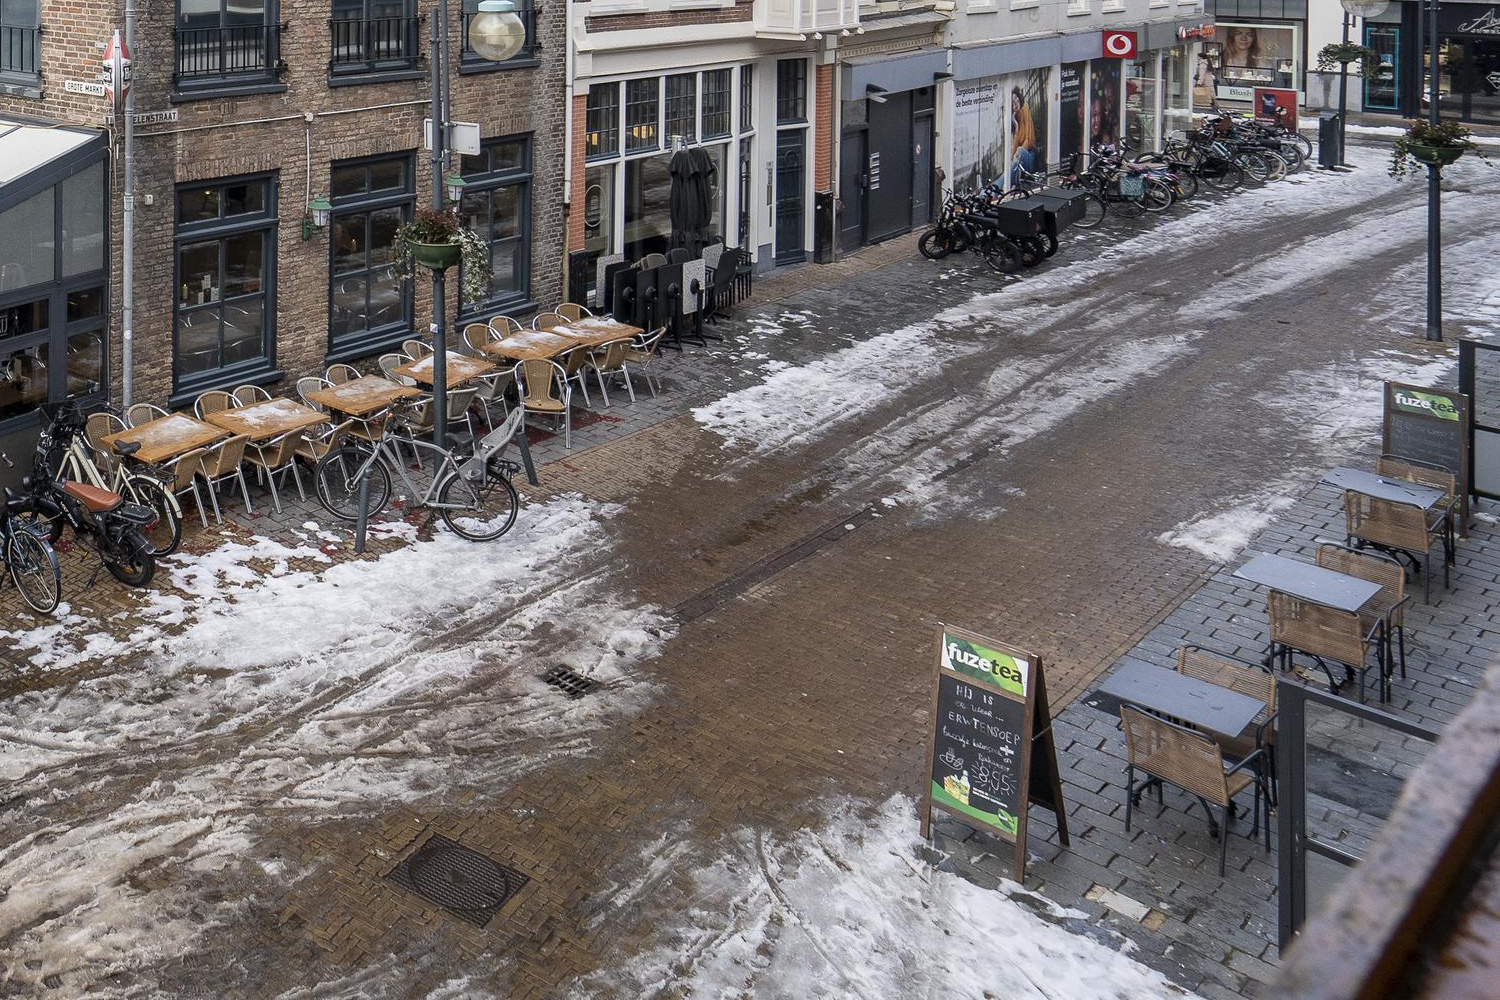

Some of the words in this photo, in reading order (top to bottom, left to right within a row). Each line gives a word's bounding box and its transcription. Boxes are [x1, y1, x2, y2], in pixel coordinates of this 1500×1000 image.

[68, 82, 83, 92] GROTE
[85, 85, 102, 95] MARKT
[1229, 89, 1252, 97] Blush
[133, 112, 177, 124] ELENSTRAAT
[1395, 393, 1457, 414] fuzetea
[948, 642, 1022, 684] fuzetea
[956, 685, 973, 700] HIJ
[983, 694, 994, 705] IS
